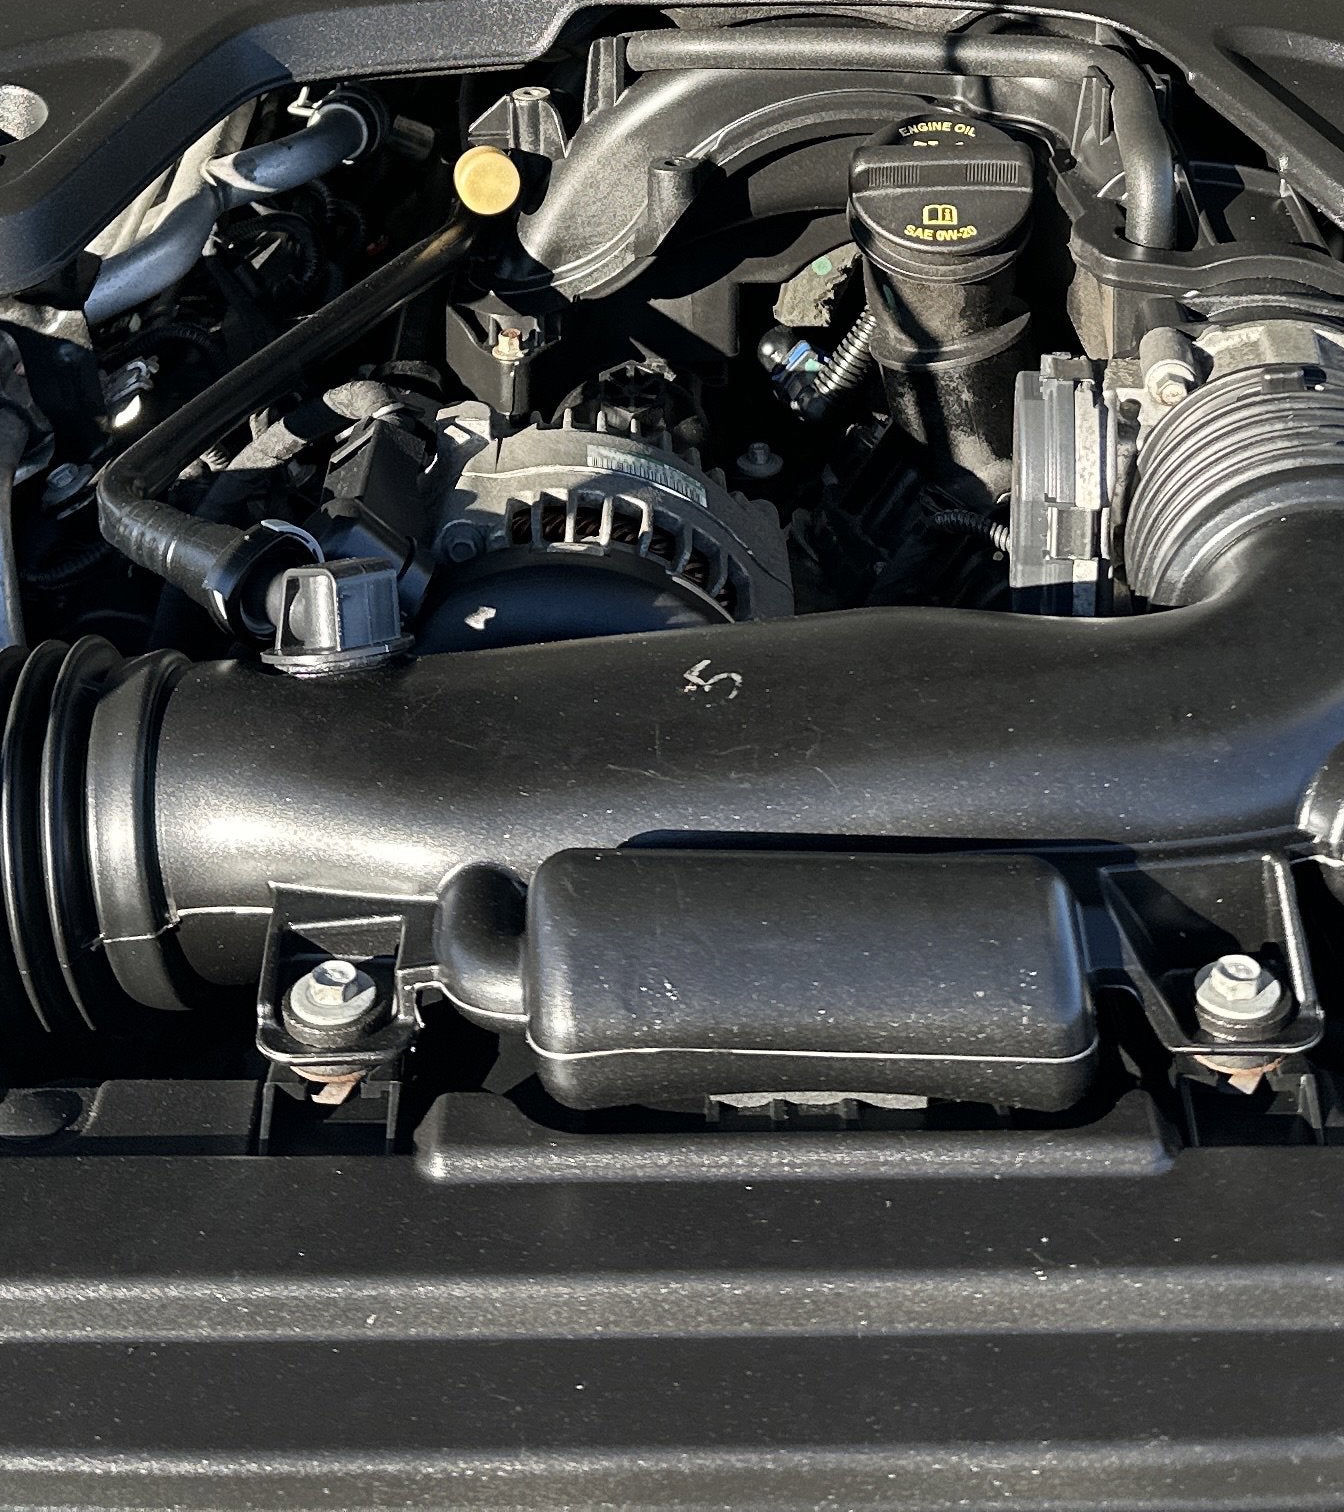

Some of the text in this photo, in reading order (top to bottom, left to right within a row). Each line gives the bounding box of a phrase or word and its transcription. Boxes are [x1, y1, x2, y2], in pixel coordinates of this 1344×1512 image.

[898, 121, 977, 138] ENGINE OIL
[903, 224, 978, 241] SAE 0W-20
